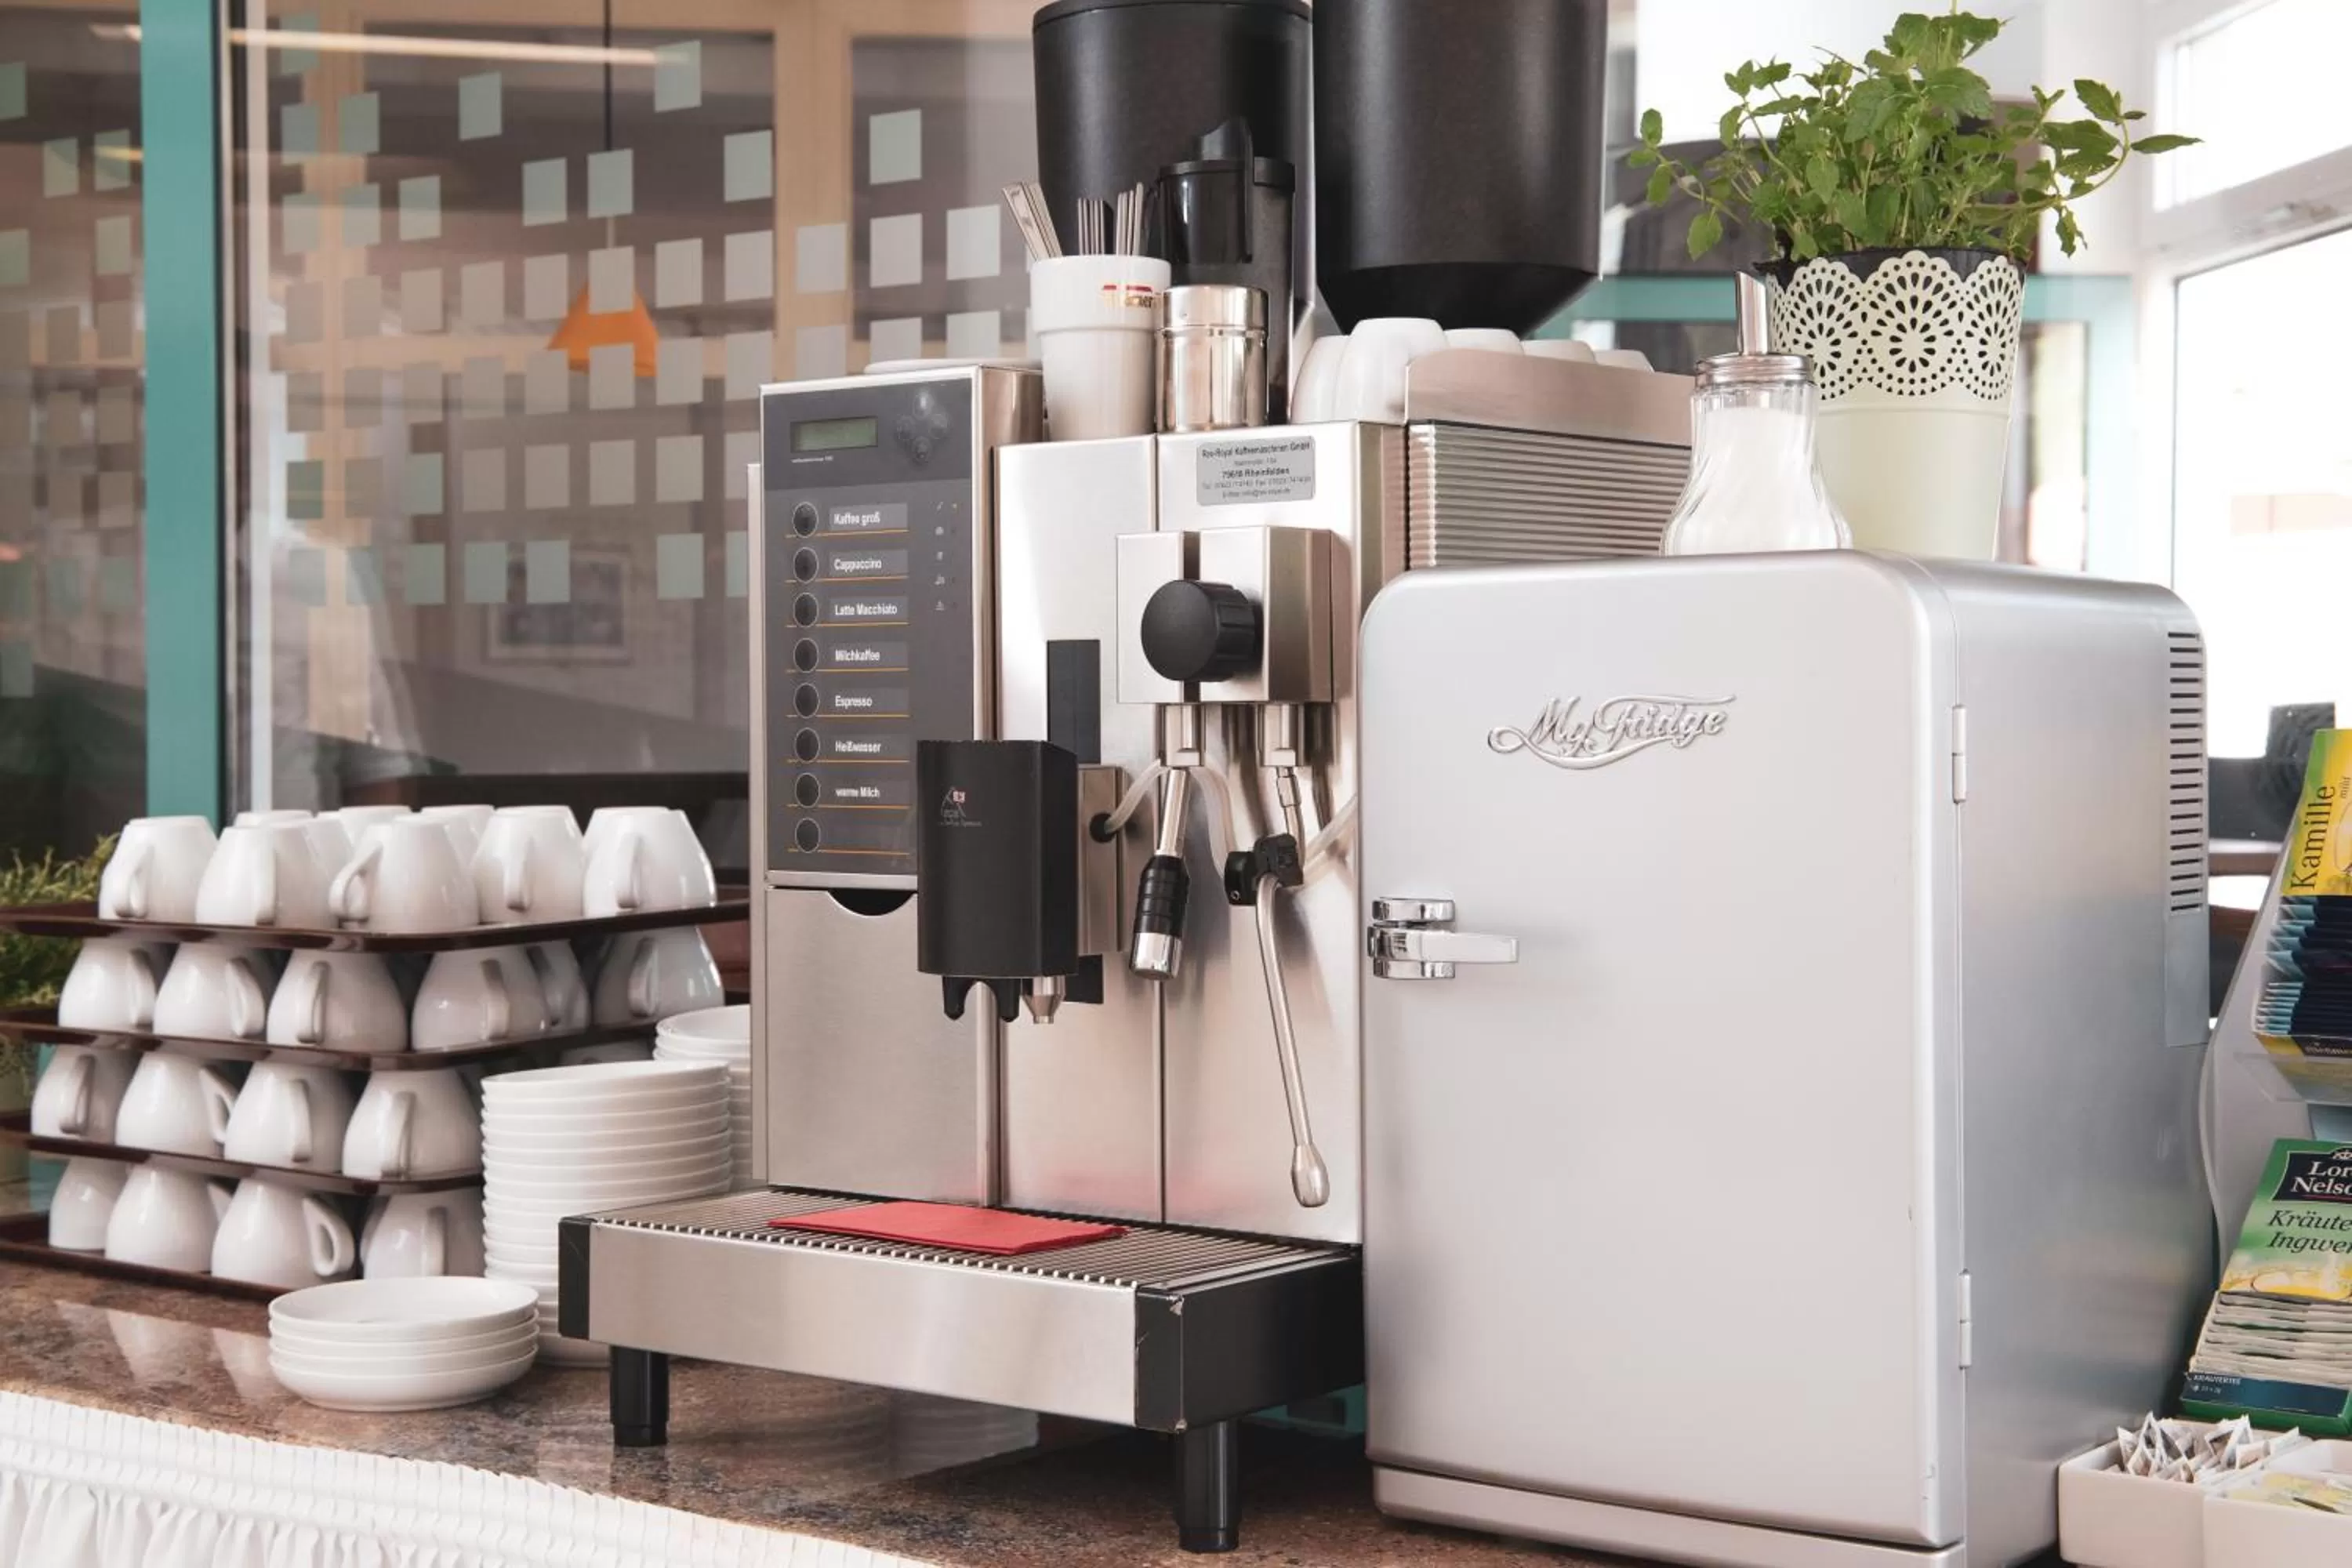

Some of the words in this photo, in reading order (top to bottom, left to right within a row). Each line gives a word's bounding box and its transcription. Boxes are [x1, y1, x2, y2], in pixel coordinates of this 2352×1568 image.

[834, 513, 860, 524] Kaffee
[834, 559, 882, 572] Cappuccino
[835, 604, 855, 615] Latte
[856, 603, 898, 615] Macchiato
[835, 649, 880, 662] Milchkaffee
[835, 695, 873, 709] Espresso
[1593, 695, 1737, 751] Fridge
[859, 786, 880, 798] Milch
[2291, 786, 2335, 890] Kamille
